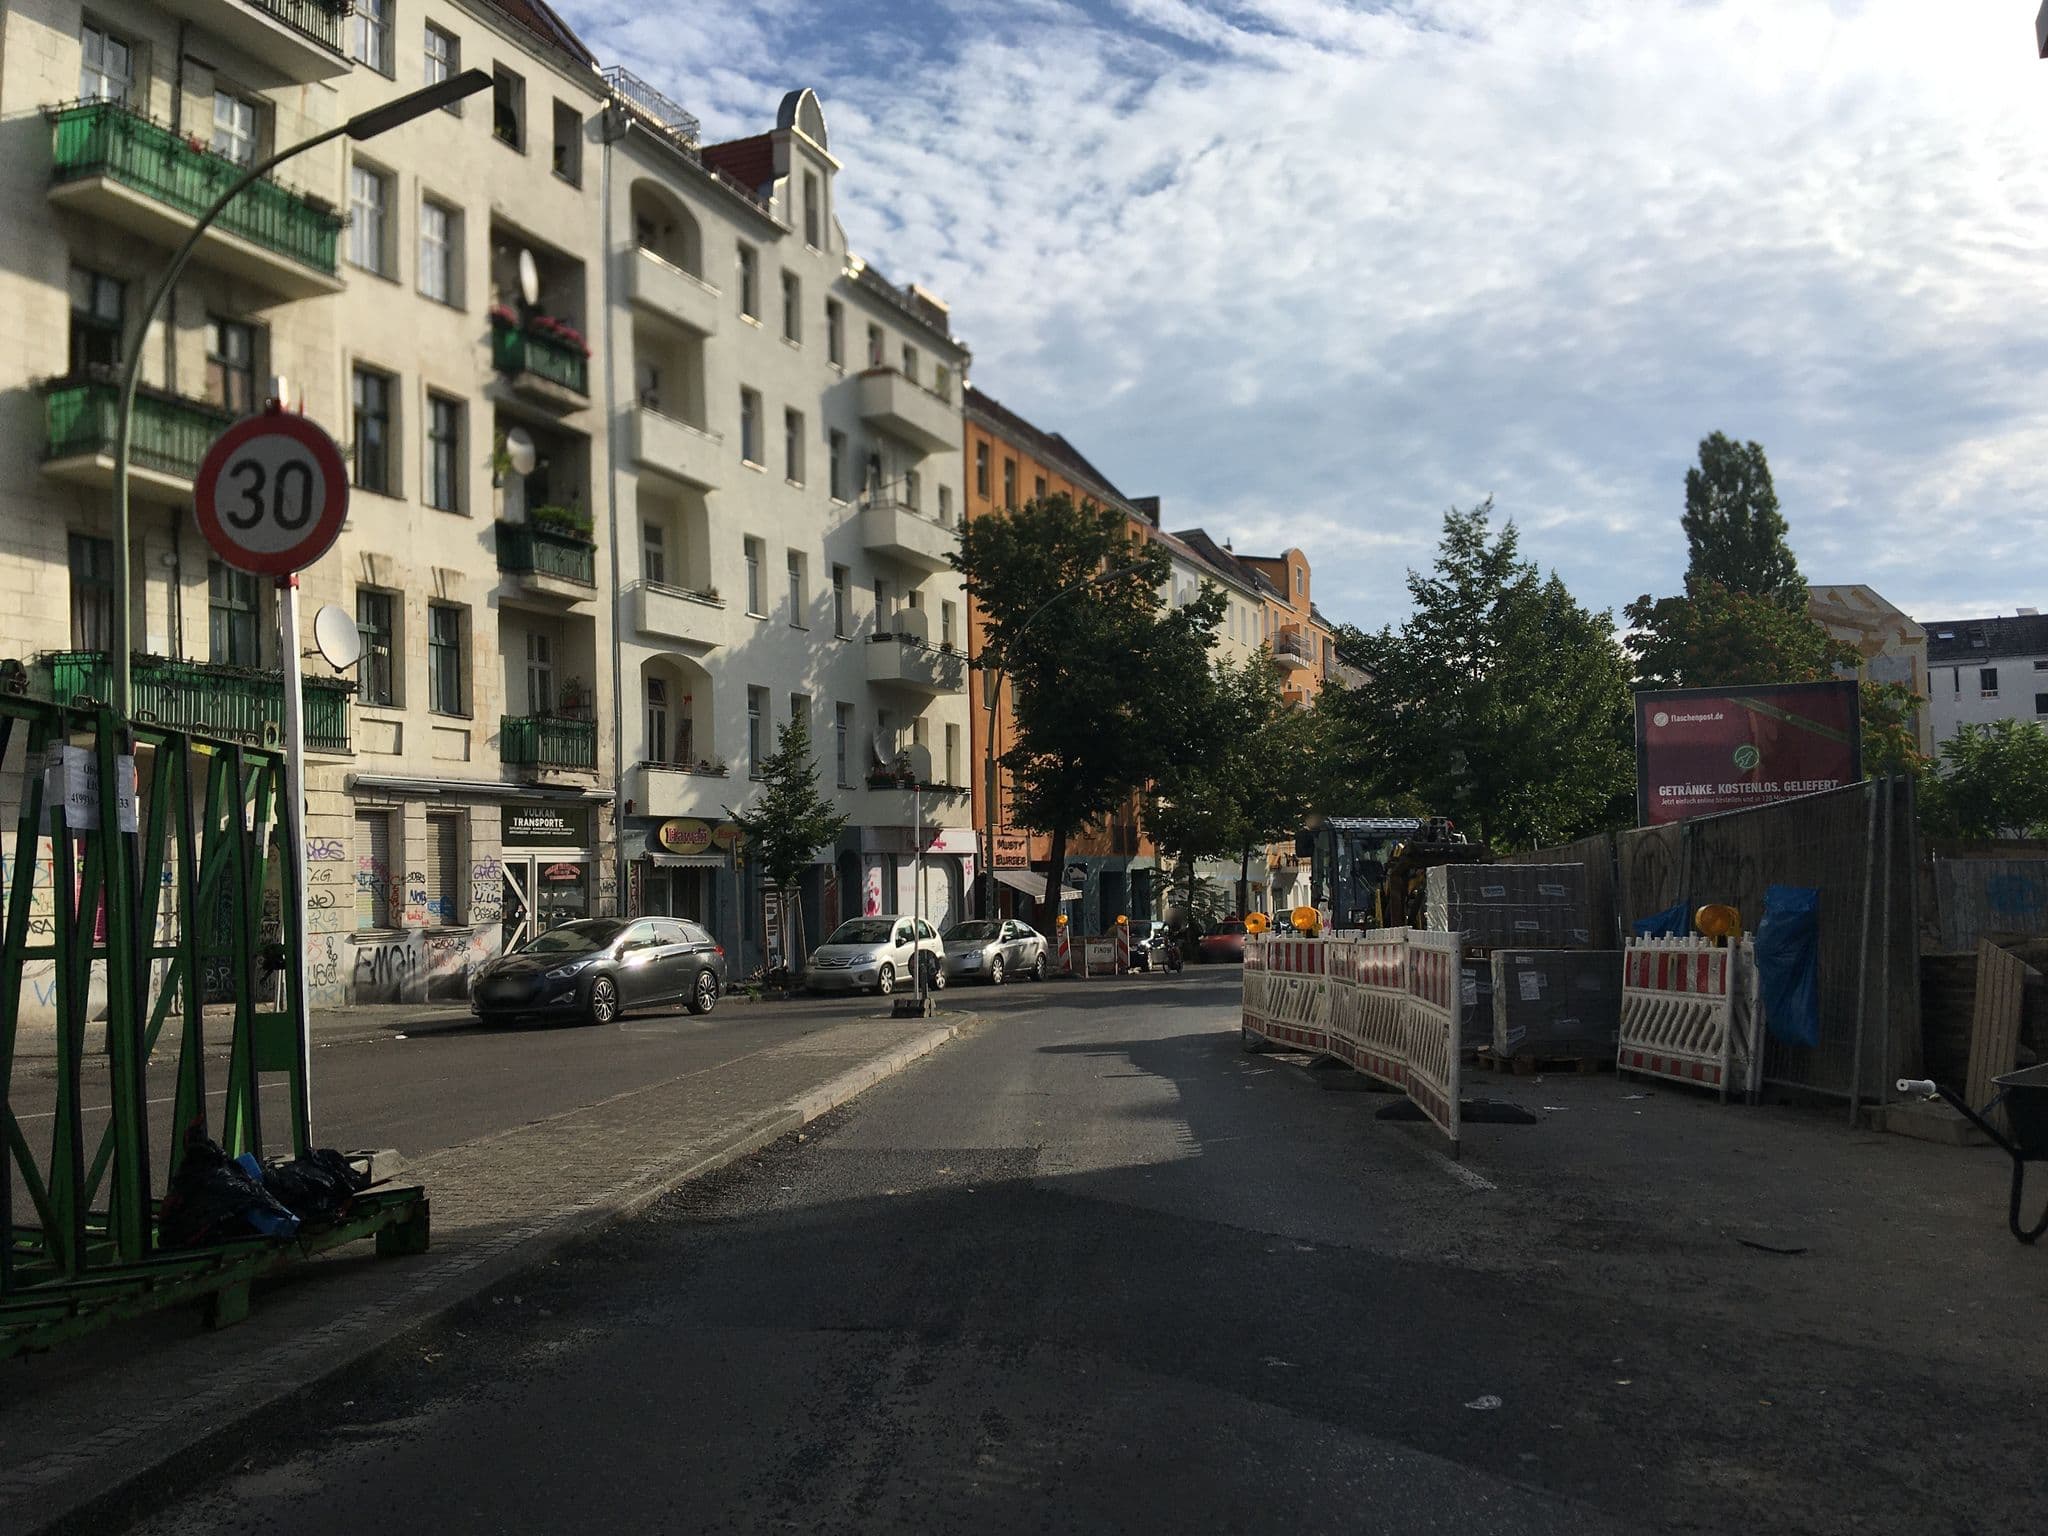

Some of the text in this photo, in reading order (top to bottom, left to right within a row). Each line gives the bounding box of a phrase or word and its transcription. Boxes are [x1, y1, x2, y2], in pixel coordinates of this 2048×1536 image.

[226, 459, 313, 530] 30
[1658, 782, 1716, 796] GETRÄNKE.
[1718, 781, 1781, 794] KOSTENLOS.
[523, 808, 556, 818] VULKAN
[513, 817, 564, 828] TRANSPORTE
